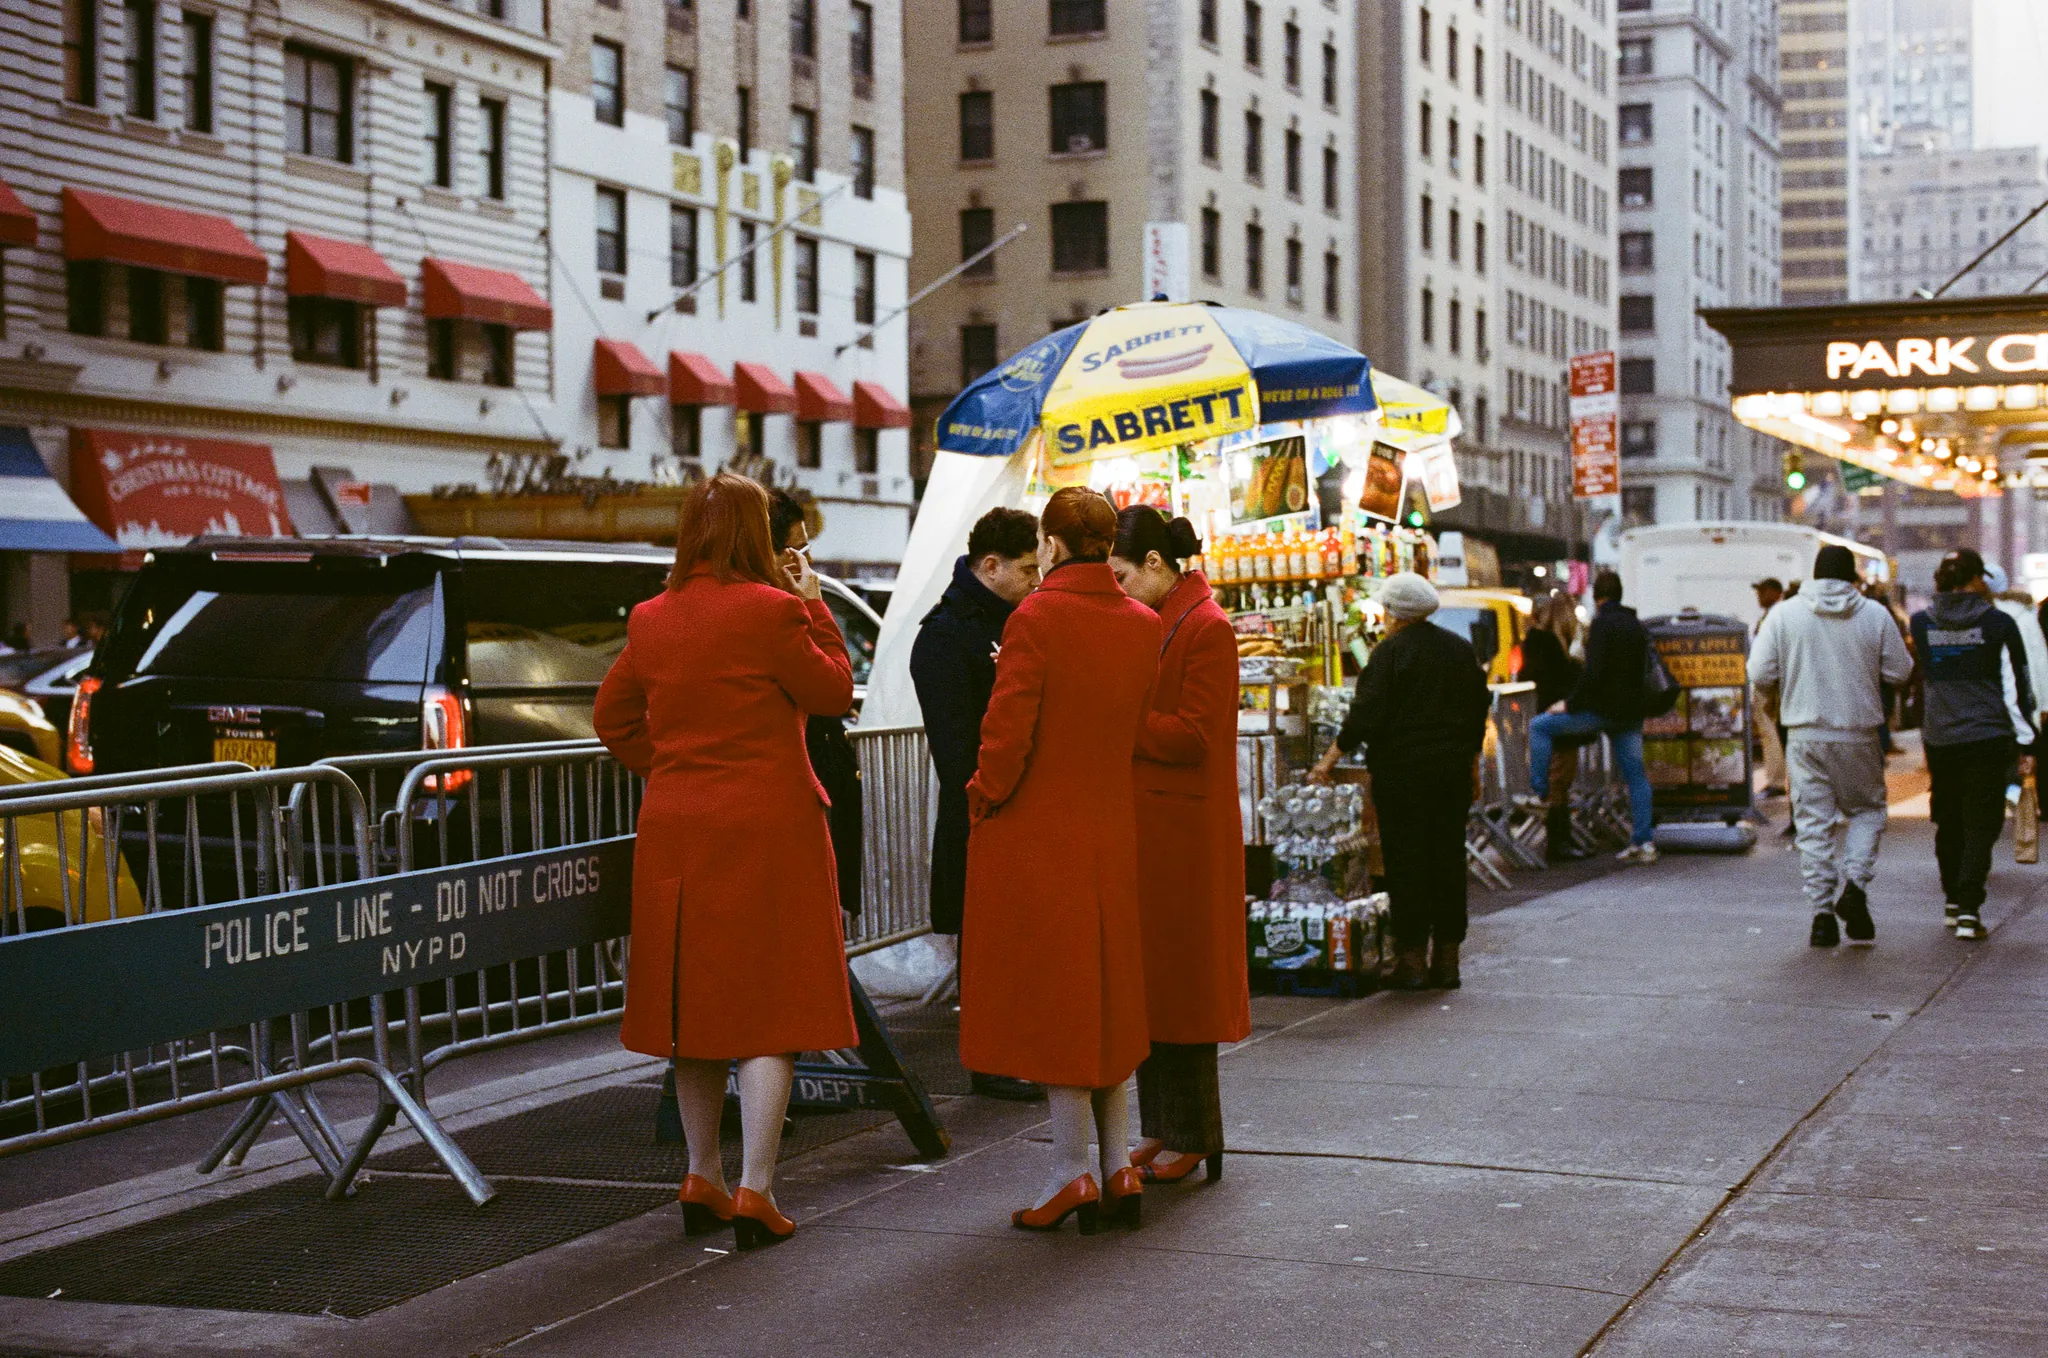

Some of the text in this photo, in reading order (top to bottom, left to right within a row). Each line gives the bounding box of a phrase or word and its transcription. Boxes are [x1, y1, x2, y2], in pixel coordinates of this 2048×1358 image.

[1081, 323, 1206, 373] SABRETT
[1826, 336, 1980, 379] PARK
[1058, 386, 1245, 455] SABRETT
[207, 706, 261, 722] GMC
[205, 907, 309, 968] POLICE
[336, 892, 394, 944] LINE
[437, 879, 467, 923] DO
[479, 869, 523, 915] NOT
[532, 856, 600, 904] CROSS
[381, 931, 466, 975] NYPD
[800, 1078, 875, 1104] DEPT.
